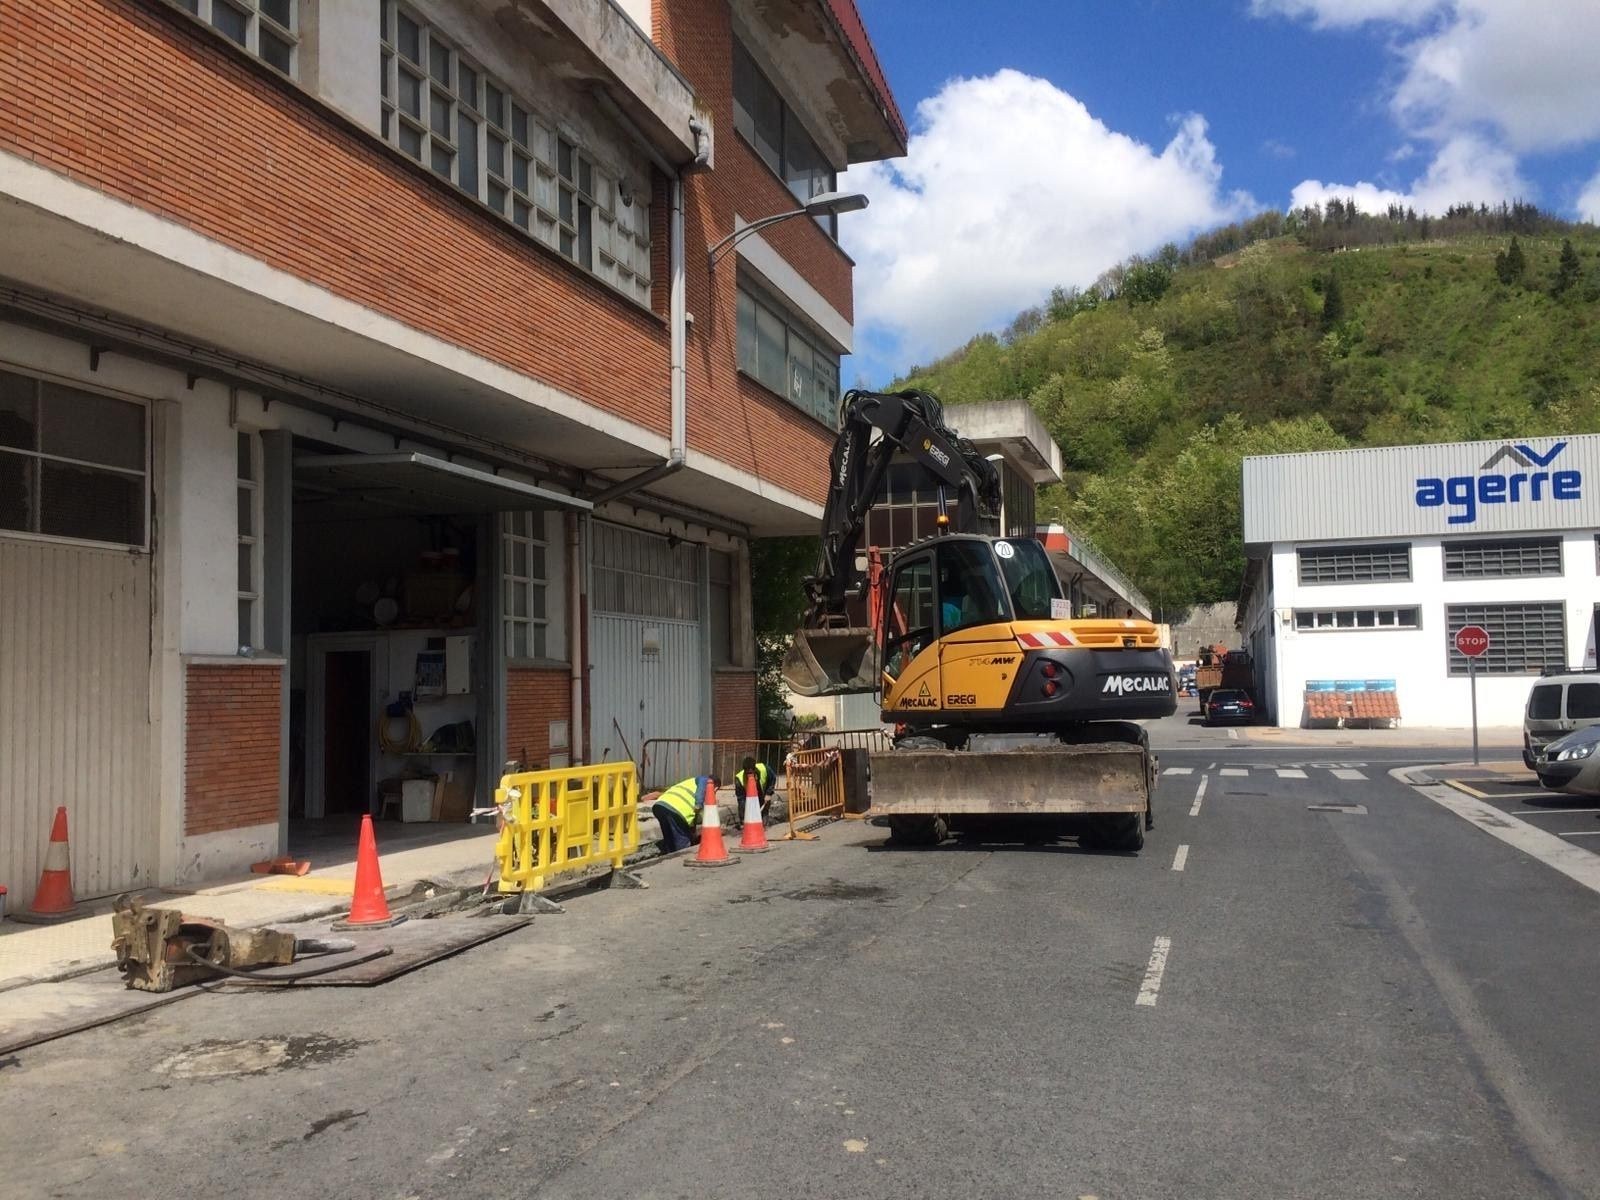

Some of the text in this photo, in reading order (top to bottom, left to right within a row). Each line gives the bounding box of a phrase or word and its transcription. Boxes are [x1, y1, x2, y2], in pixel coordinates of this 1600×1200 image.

[1415, 470, 1582, 525] agerre
[997, 543, 1012, 556] 20
[1458, 637, 1487, 646] STOP
[947, 694, 977, 705] EREGI
